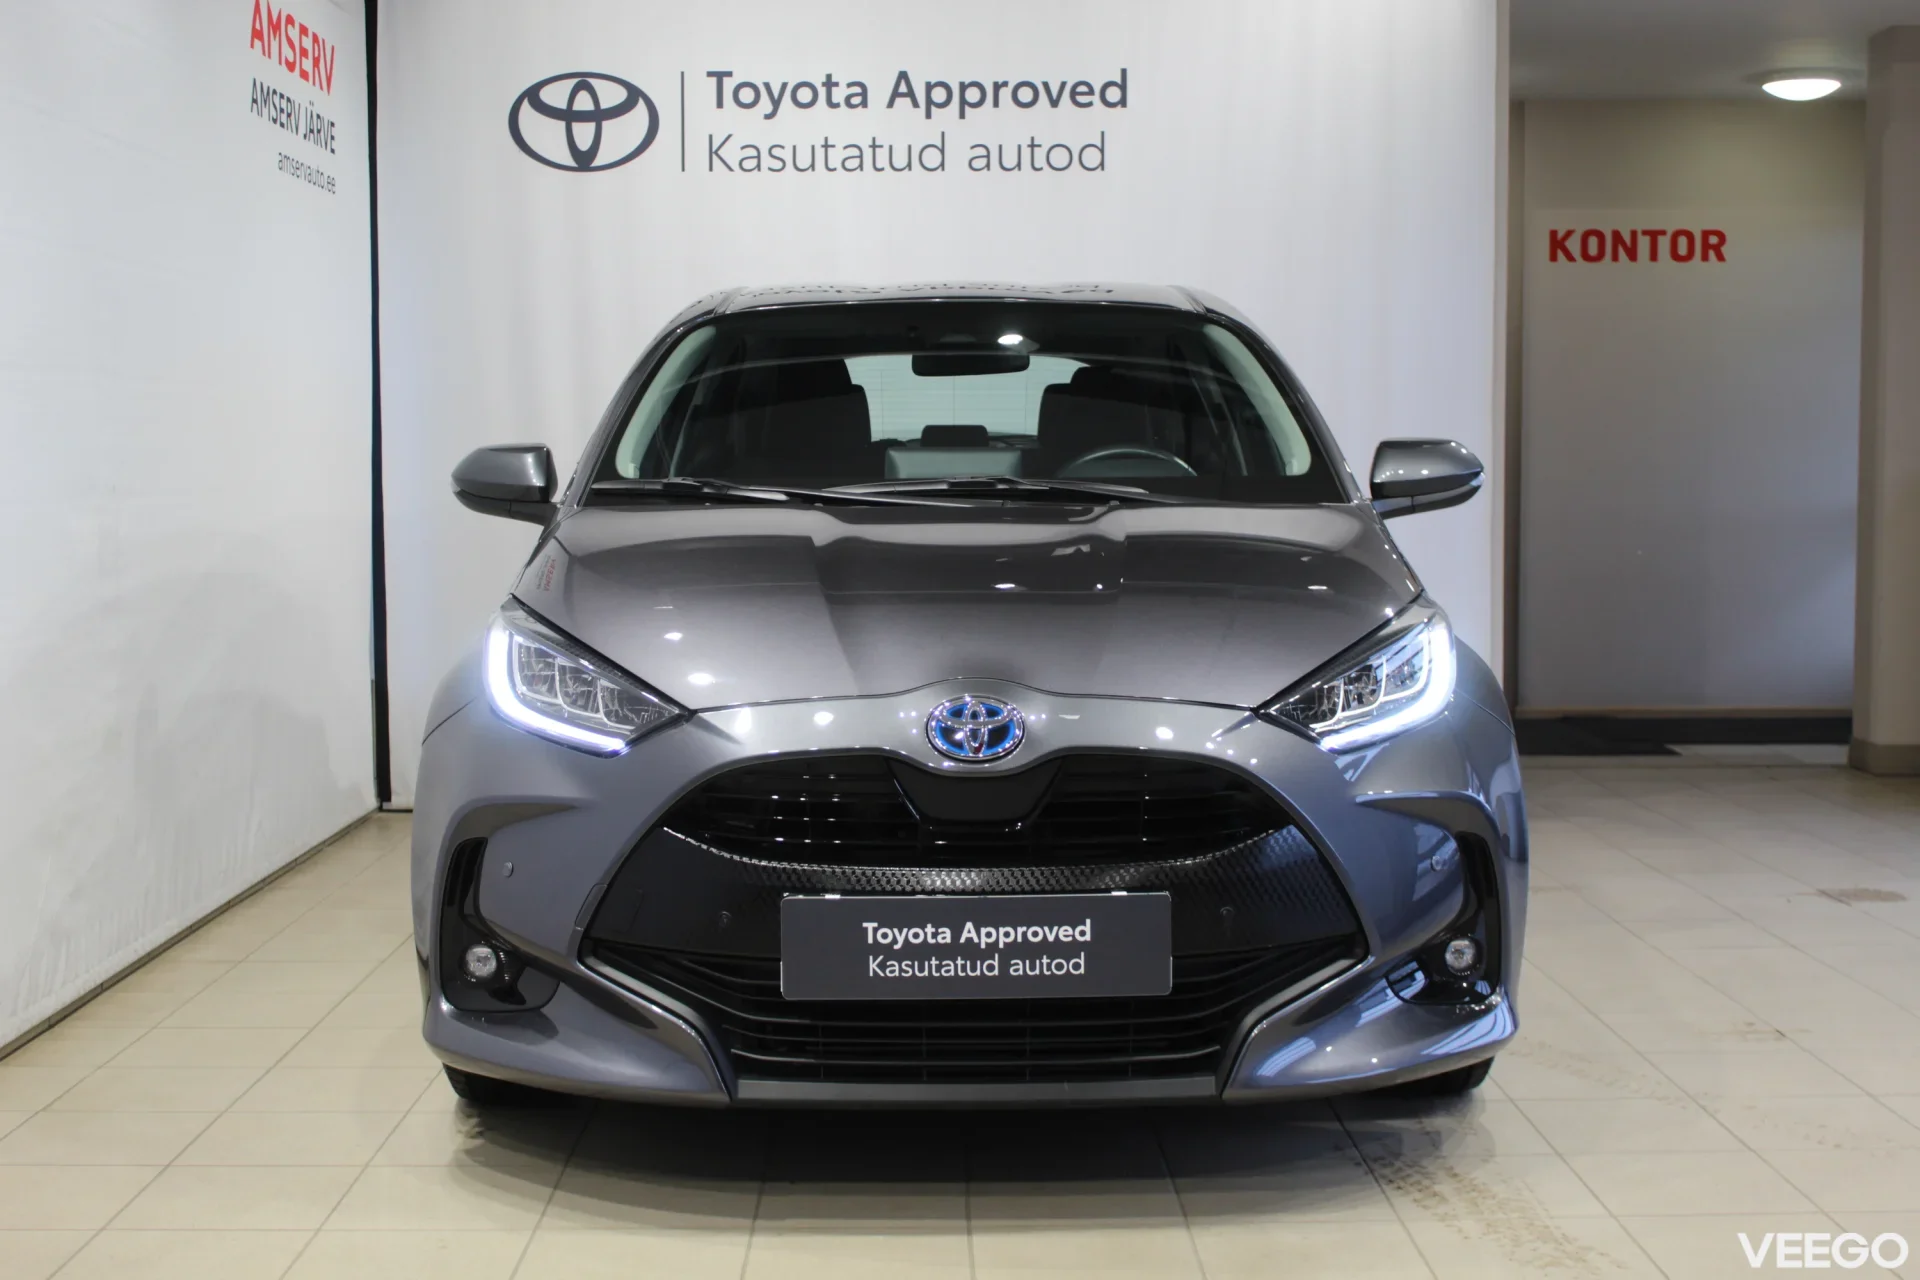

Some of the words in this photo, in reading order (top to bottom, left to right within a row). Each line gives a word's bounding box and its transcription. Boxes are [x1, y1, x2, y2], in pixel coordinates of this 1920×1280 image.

[250, 0, 335, 96] AMSERV
[707, 70, 869, 120] Toyota
[886, 68, 1128, 120] Approved
[250, 77, 301, 136] AMSERV
[303, 100, 336, 155] JÄRVE
[277, 151, 336, 195] amservauto.ee
[708, 131, 945, 173] Kasutatud
[968, 131, 1105, 172] autod
[1548, 228, 1727, 263] KONTOR
[862, 922, 952, 950] Toyota
[960, 918, 1092, 949] Approved
[868, 953, 1000, 977] Kasutatud
[1009, 952, 1086, 976] autod
